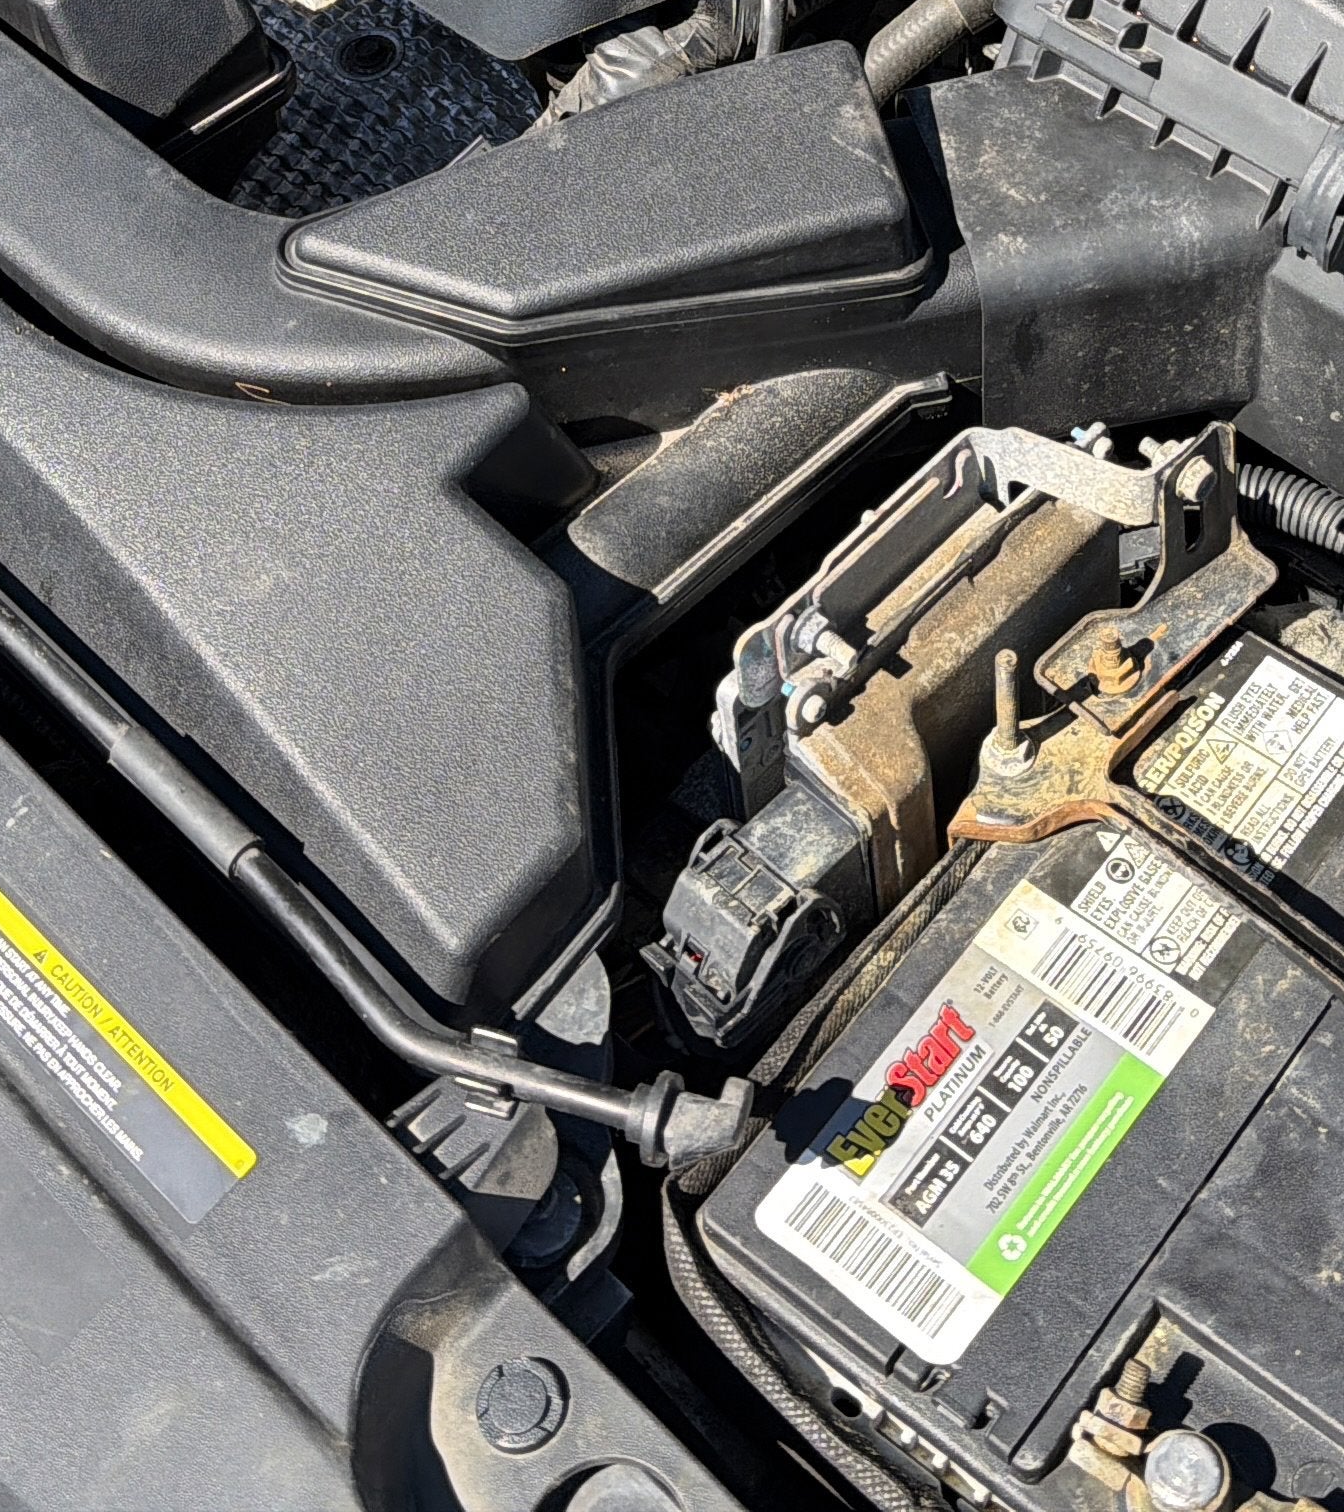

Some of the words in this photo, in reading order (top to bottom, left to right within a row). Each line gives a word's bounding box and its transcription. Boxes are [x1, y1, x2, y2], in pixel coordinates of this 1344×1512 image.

[1220, 700, 1246, 729] FLUSH
[1240, 680, 1261, 704] EYES
[1232, 682, 1278, 736] IMMEDIATELY
[1285, 682, 1317, 719] MEDICAL
[1137, 689, 1226, 796] GER/POISON
[1244, 718, 1267, 743] WITH
[1290, 710, 1313, 735] HELP
[1174, 746, 1210, 788] SULFURIC
[1187, 773, 1209, 797] ACID
[1076, 879, 1107, 913] SHIELD
[1090, 892, 1116, 922] EYES.
[1102, 881, 1145, 930] EXPLOSIVE
[1164, 914, 1184, 936] KEEP
[1178, 897, 1197, 917] OUT
[1175, 914, 1201, 944] REACH
[1076, 931, 1124, 968] 09759
[1, 945, 30, 974] START
[24, 969, 39, 984] AT
[33, 978, 54, 1000] ANY
[972, 965, 998, 995] 12-VOLT
[983, 971, 1009, 1001] Battery
[7, 995, 24, 1011] DE
[60, 1050, 85, 1076] TOUT
[48, 962, 104, 1019] CAUTION
[107, 1023, 175, 1093] ATTENTION
[1042, 1023, 1066, 1049] 50
[66, 1034, 99, 1067] HANDS
[1028, 1025, 1093, 1103] NONSPILLABLE
[20, 1030, 38, 1047] NE
[31, 1041, 53, 1063] PAS
[55, 1067, 107, 1120] APPROCHER
[100, 1114, 120, 1135] LES
[823, 998, 981, 1182] EverStart
[921, 1043, 987, 1122] PLATINUM
[1006, 1062, 1036, 1095] 100
[966, 1111, 999, 1146] 640
[982, 1145, 1021, 1192] Distributed
[1014, 1136, 1030, 1151] by
[1022, 1103, 1052, 1140] Walmart
[985, 1195, 1003, 1214] 702
[996, 1183, 1012, 1200] SW
[1024, 1112, 1065, 1162] Bentonville,
[1058, 1102, 1073, 1118] AR
[1066, 1082, 1088, 1107] 72716
[912, 1176, 948, 1216] AGM
[937, 1158, 961, 1183] 35
